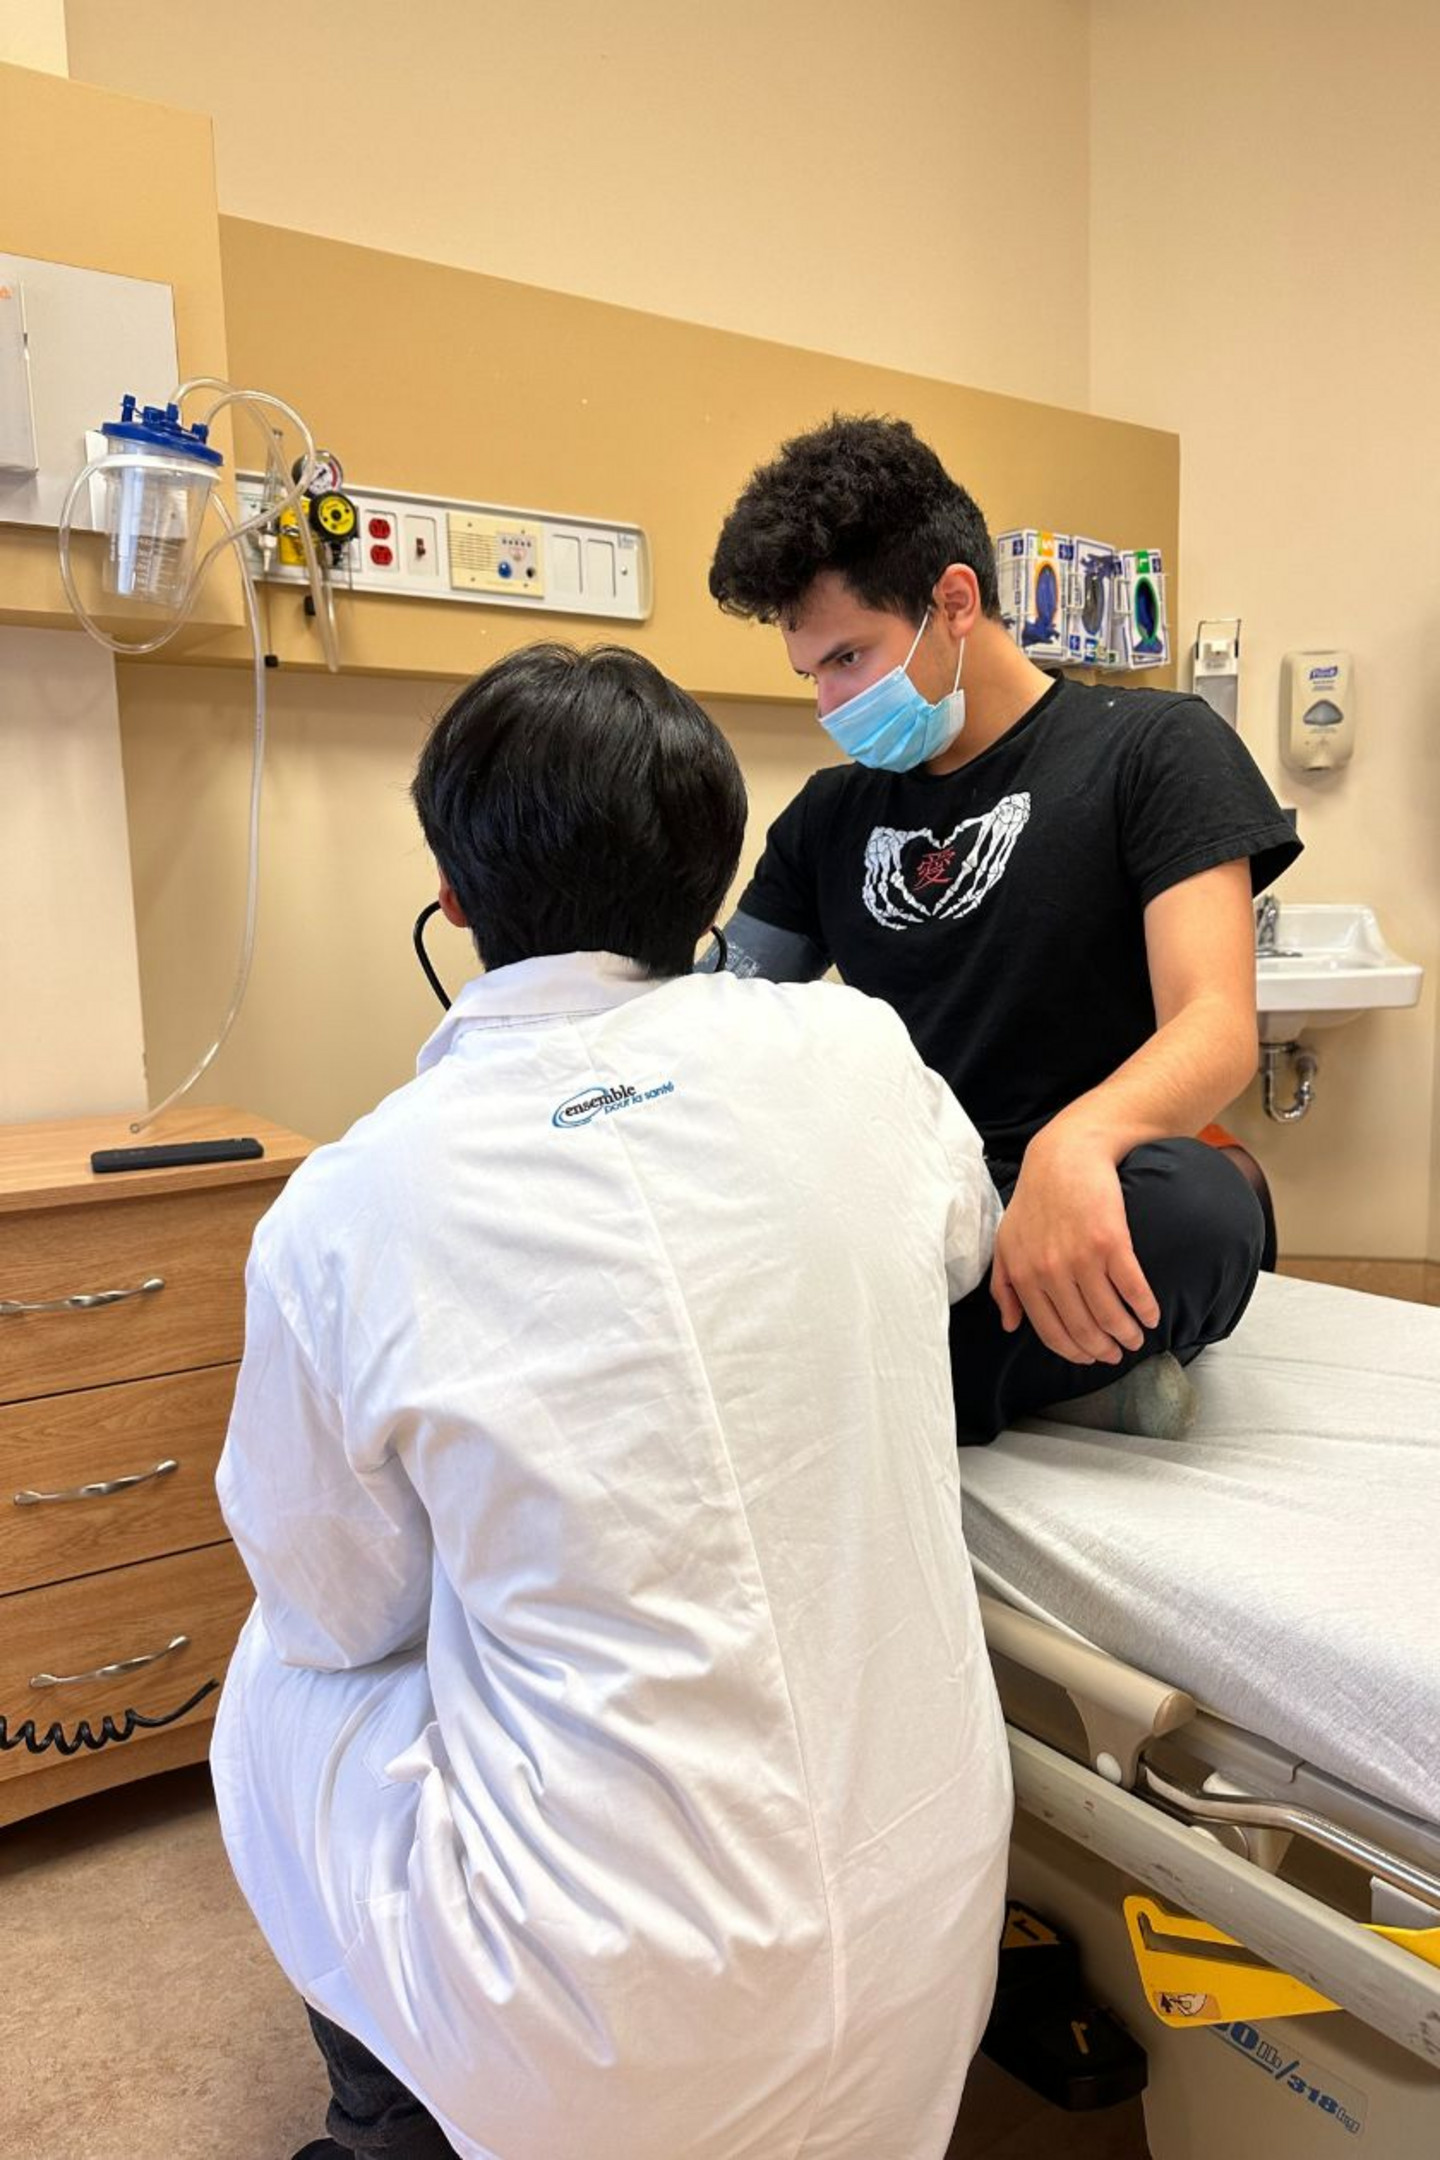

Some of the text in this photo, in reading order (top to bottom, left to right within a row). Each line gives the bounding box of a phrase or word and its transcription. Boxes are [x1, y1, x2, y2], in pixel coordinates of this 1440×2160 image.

[565, 1085, 636, 1116] ensemble
[604, 1081, 674, 1115] pour la santé
